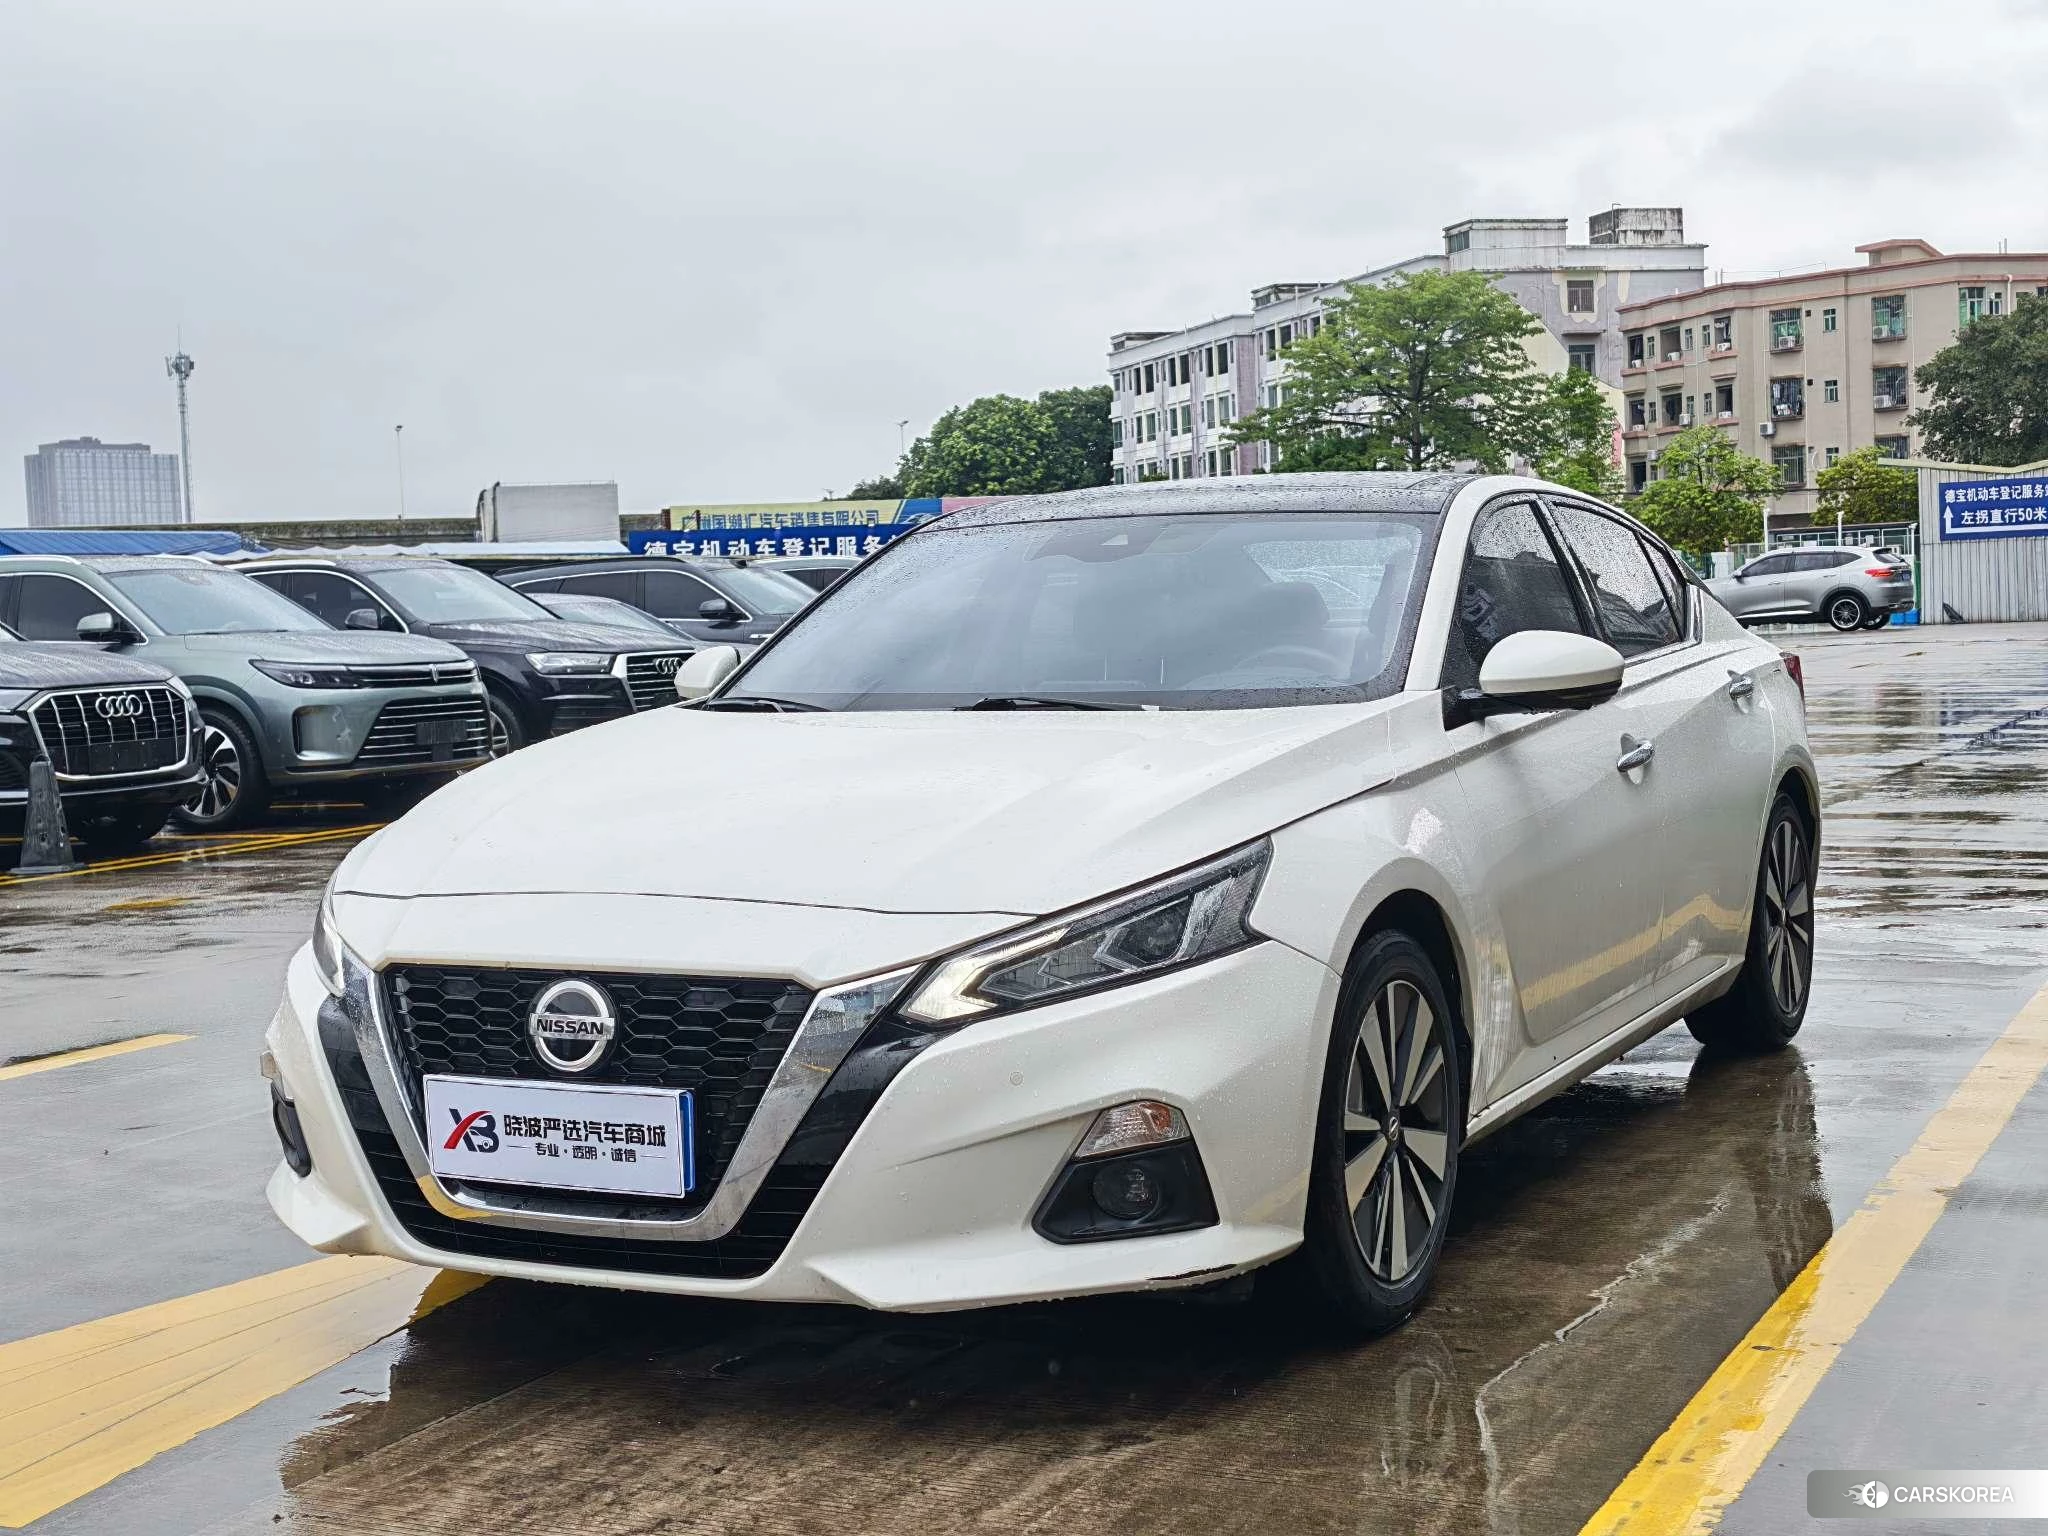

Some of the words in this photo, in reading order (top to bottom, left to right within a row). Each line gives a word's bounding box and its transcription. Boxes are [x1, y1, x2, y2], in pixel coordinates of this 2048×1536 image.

[1962, 506, 2047, 524] 左拐直行50米
[644, 535, 897, 556] 德宝机动车登记服务
[536, 1018, 604, 1035] NISSAN
[503, 1114, 666, 1147] 晓波严选汽车商城
